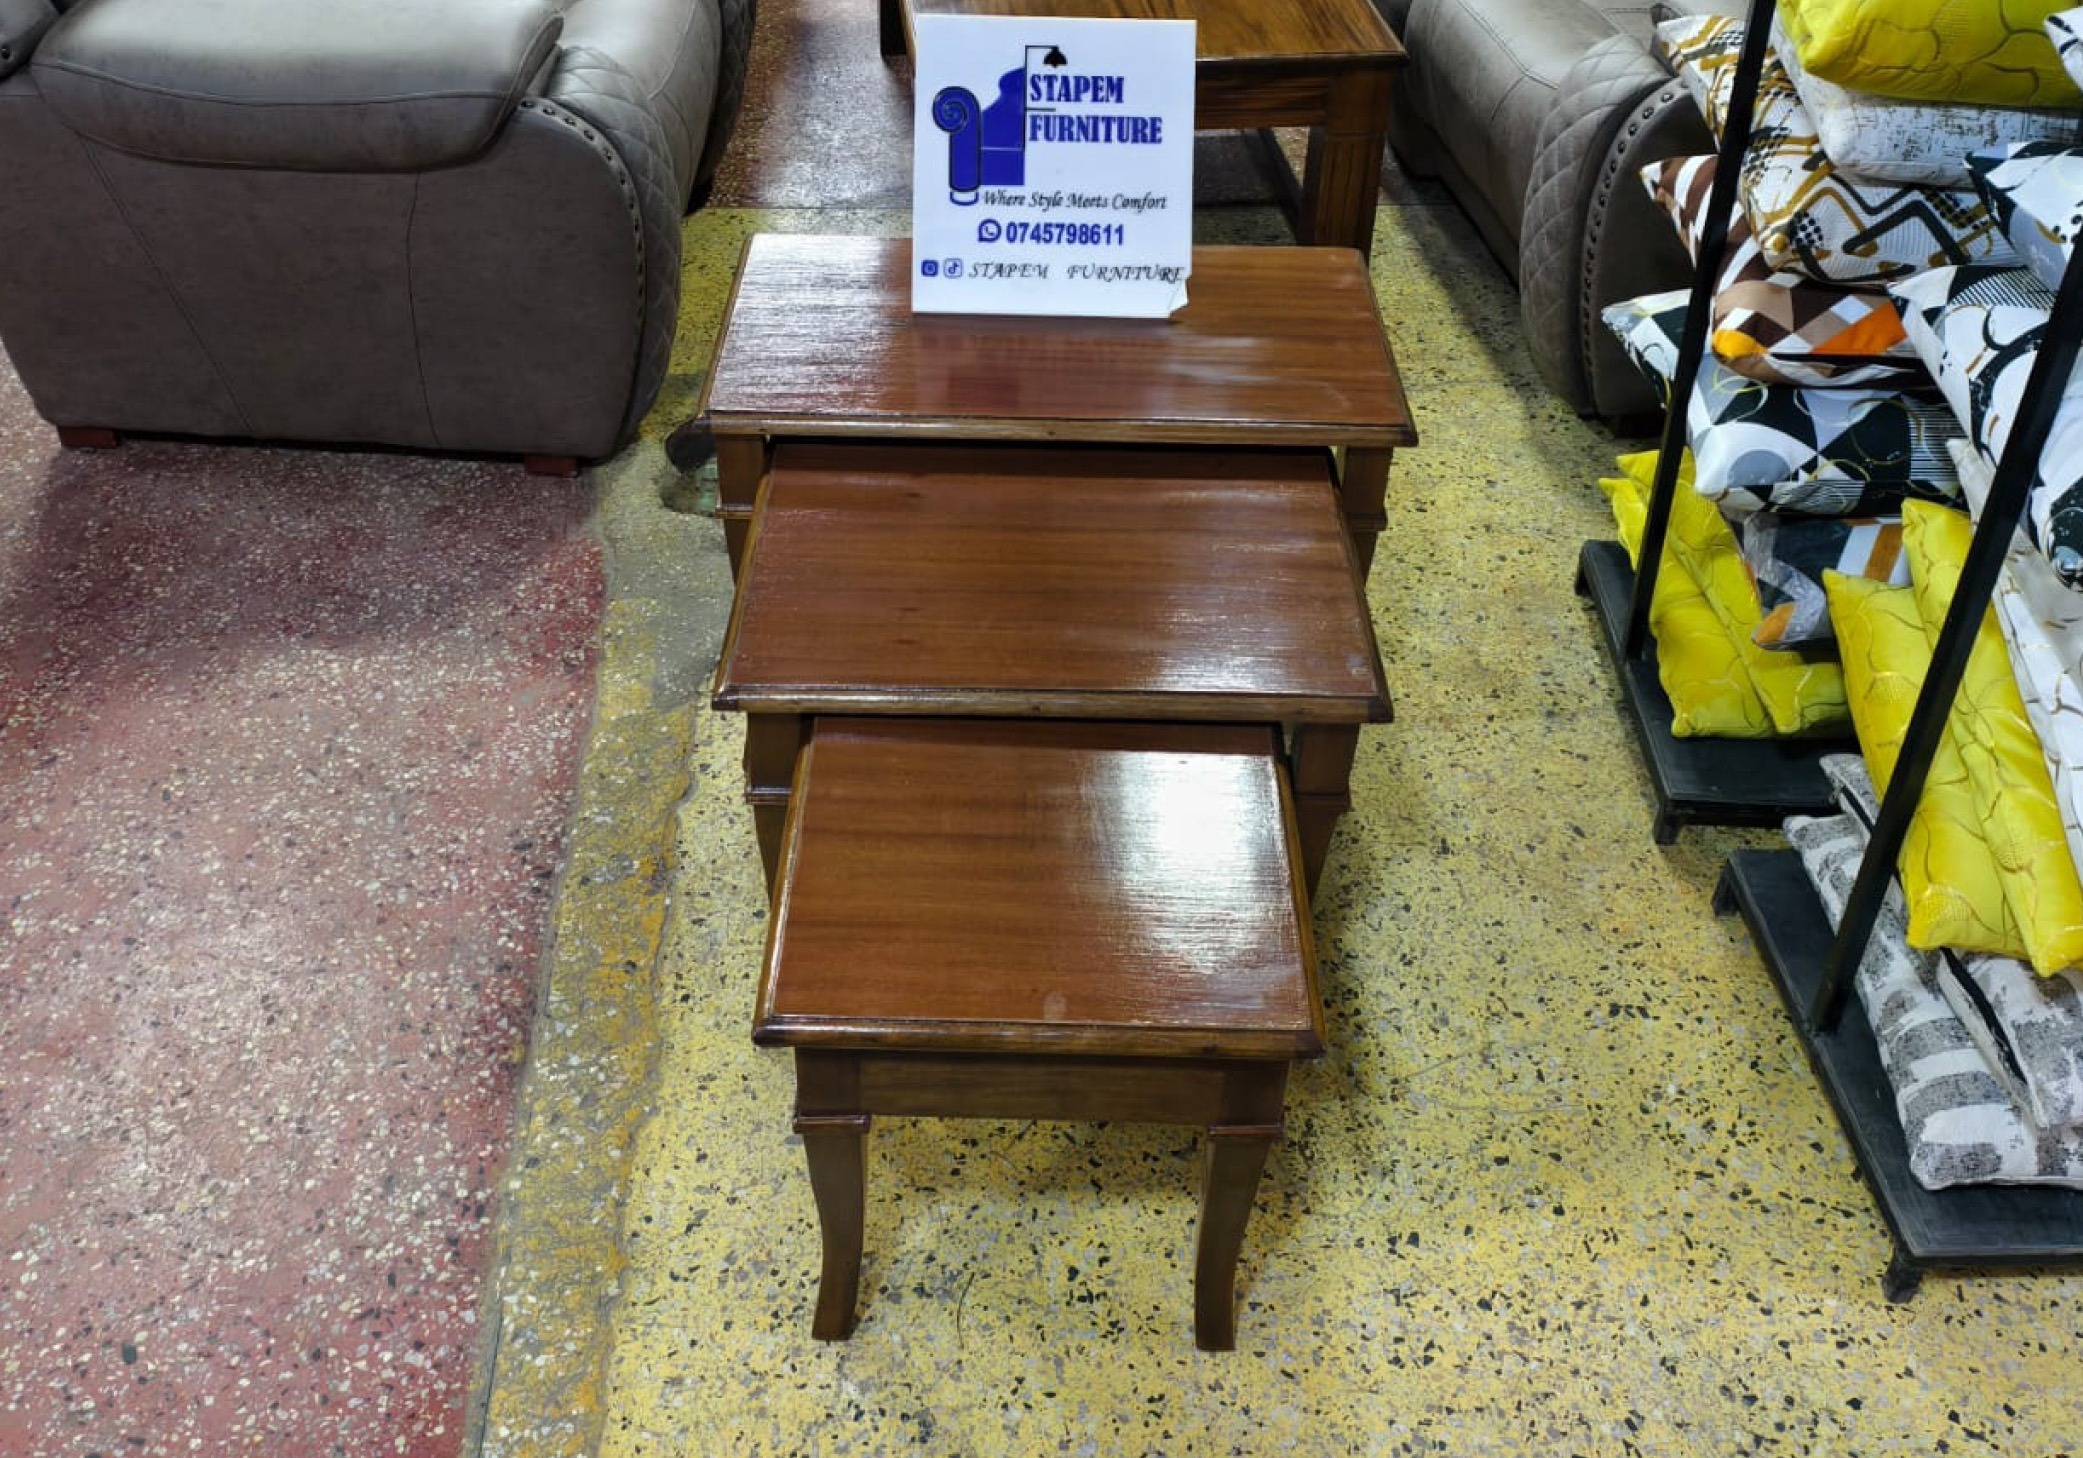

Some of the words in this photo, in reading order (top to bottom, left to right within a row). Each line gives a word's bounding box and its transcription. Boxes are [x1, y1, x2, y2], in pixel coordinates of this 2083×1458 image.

[1029, 74, 1125, 103] STAPEM
[1028, 115, 1163, 144] FURNITURE
[983, 190, 1026, 207] Where
[1028, 191, 1064, 212] Style
[1066, 193, 1108, 208] Meets
[1111, 192, 1167, 214] Comfort
[1006, 221, 1124, 245] 0745798611
[1066, 263, 1185, 283] FURNITURE
